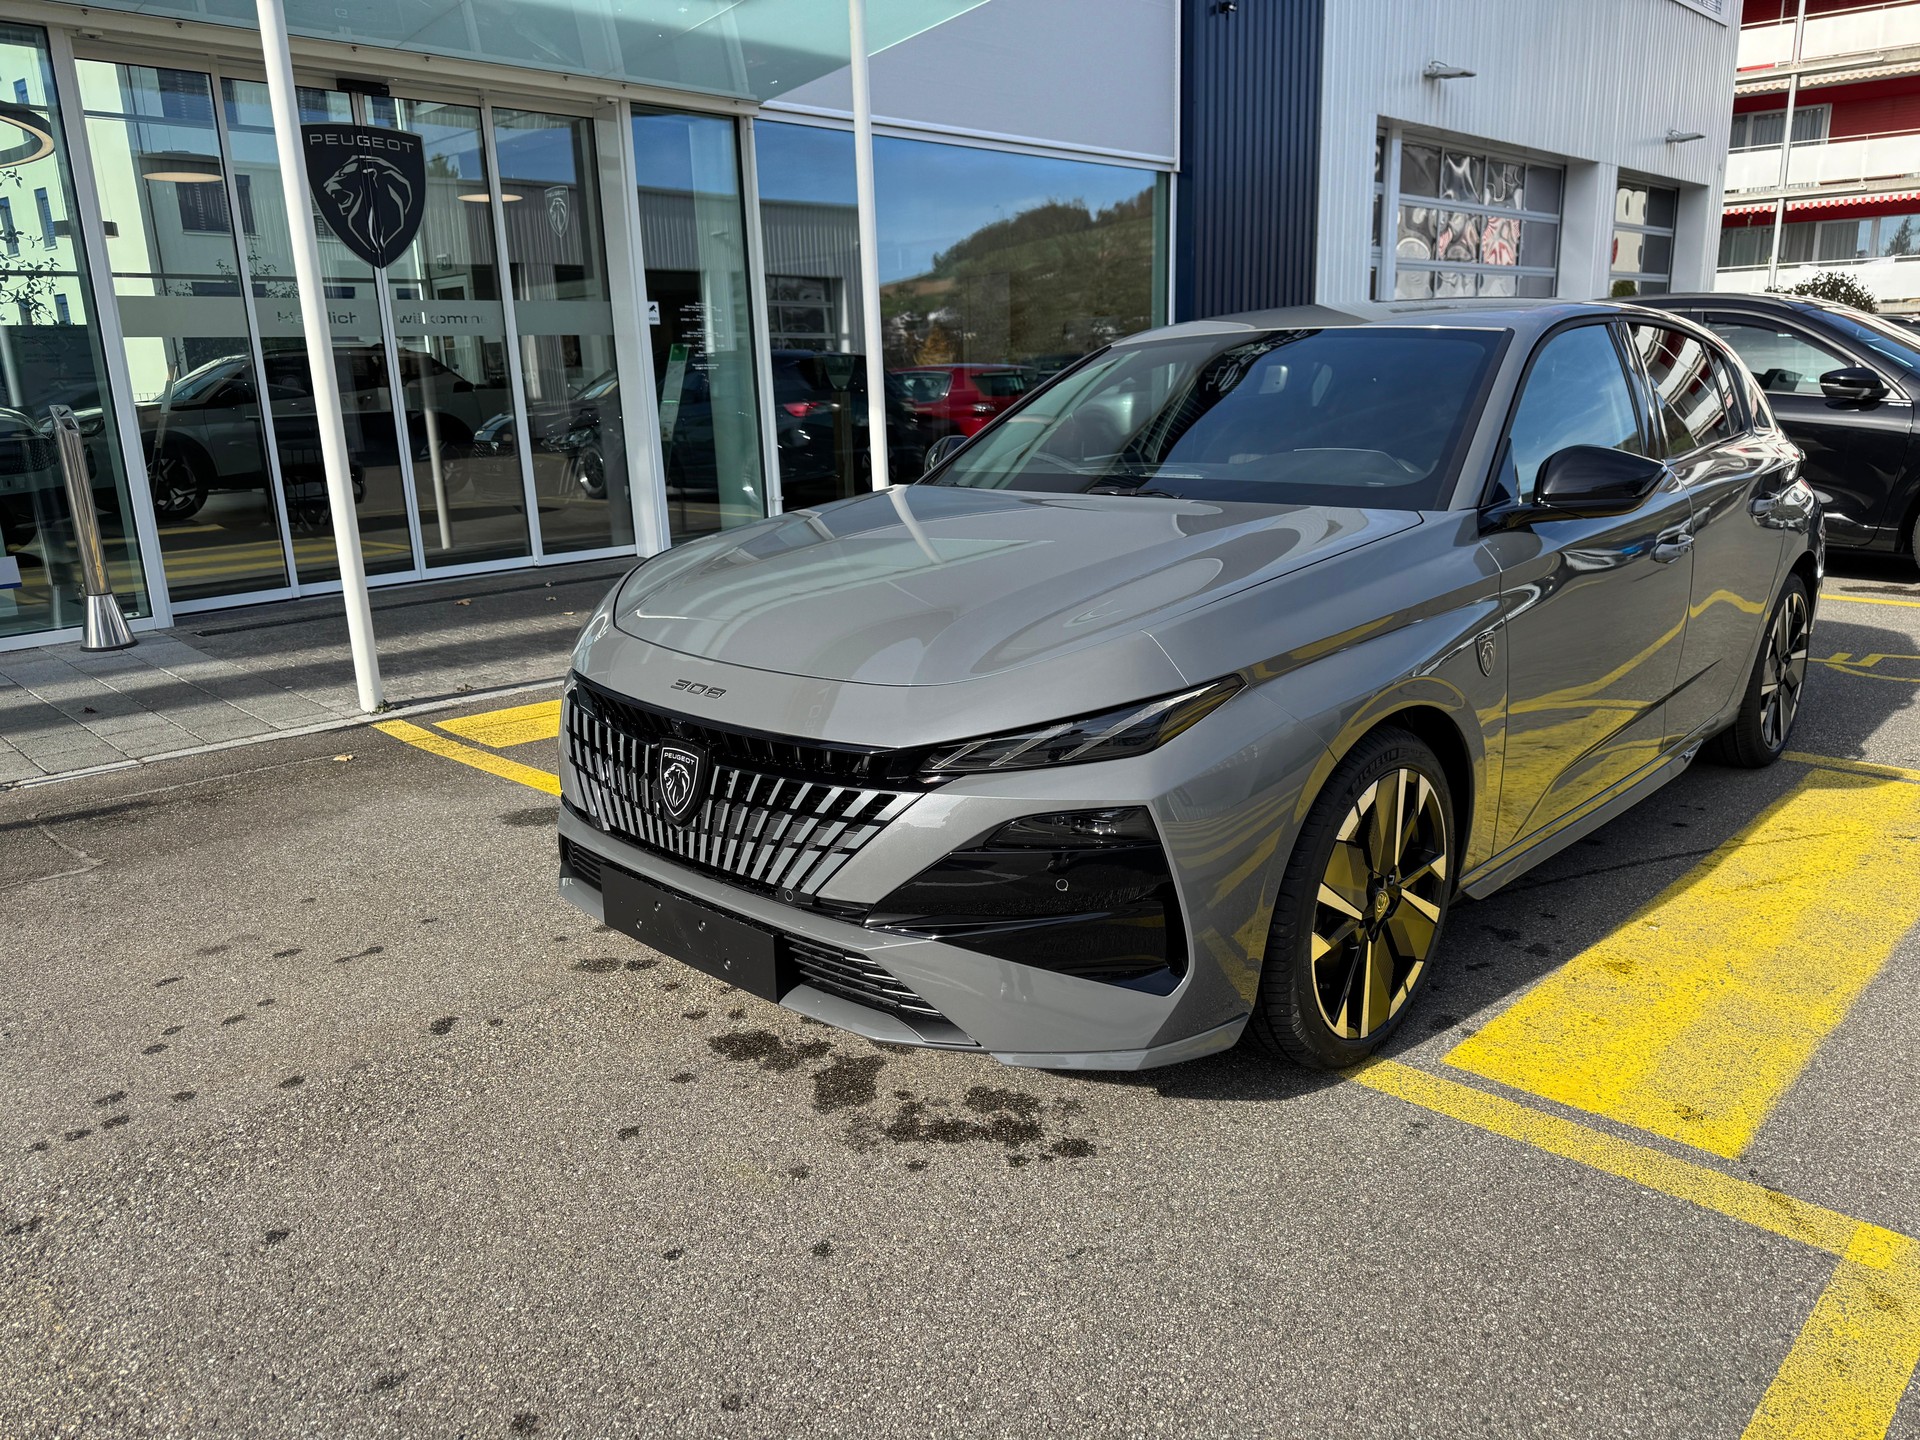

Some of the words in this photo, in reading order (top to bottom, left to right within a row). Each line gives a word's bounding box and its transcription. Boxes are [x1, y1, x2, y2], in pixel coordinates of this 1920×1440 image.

[309, 133, 414, 153] PEUGEOT
[277, 311, 360, 324] Helich
[670, 679, 727, 699] 308
[664, 752, 695, 765] PEUGEOT
[1351, 748, 1399, 795] MICHELIN
